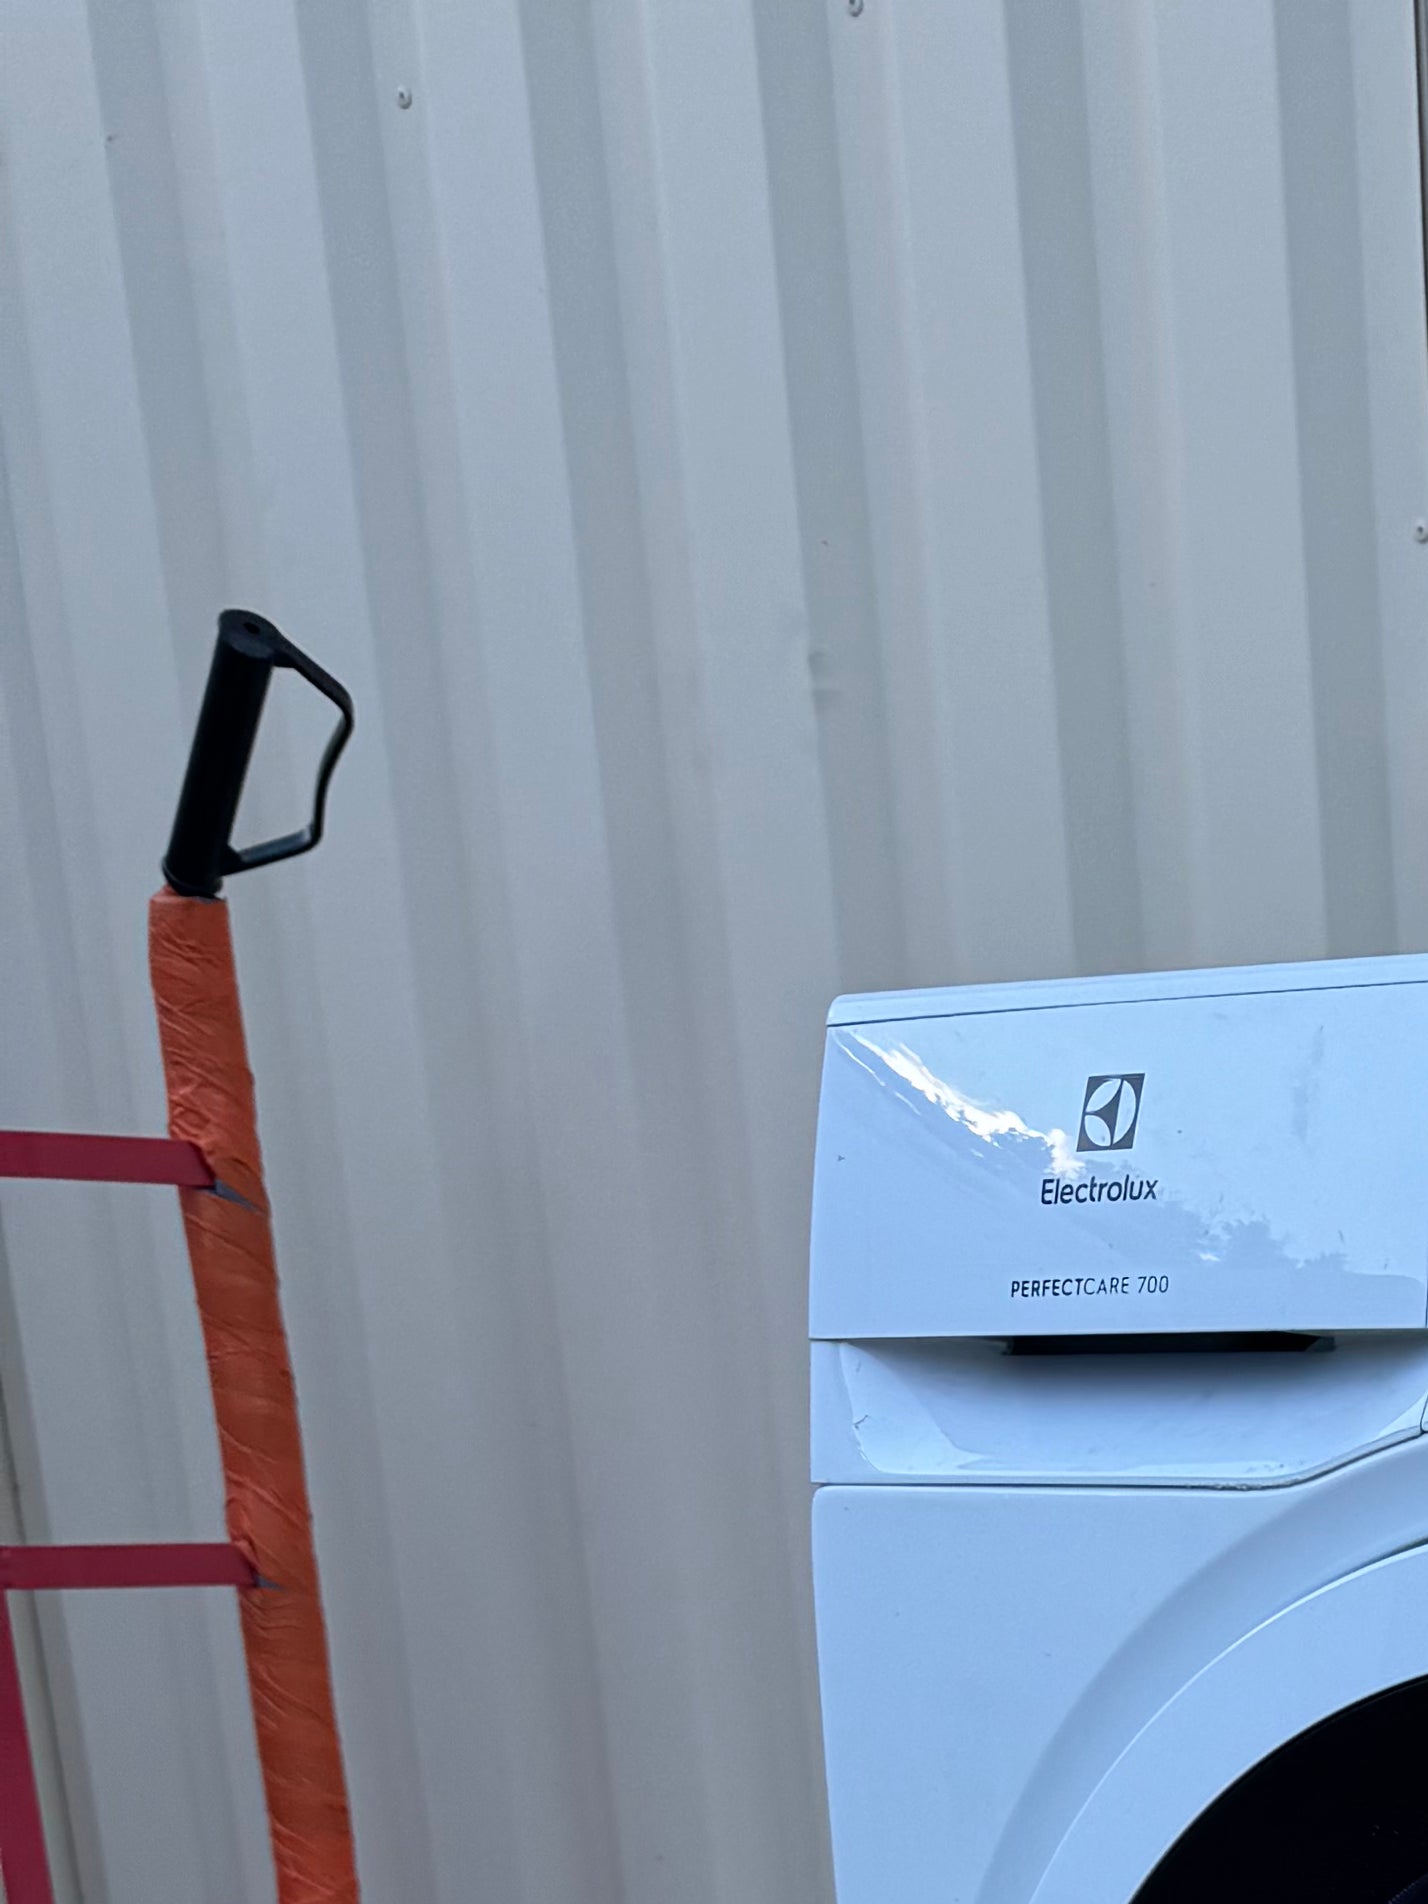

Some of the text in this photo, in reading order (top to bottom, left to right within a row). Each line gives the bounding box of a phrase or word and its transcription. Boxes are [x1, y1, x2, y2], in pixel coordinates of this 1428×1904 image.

[1040, 1174, 1158, 1205] Electrolux
[1010, 1275, 1169, 1298] PERFECTCARE 700
